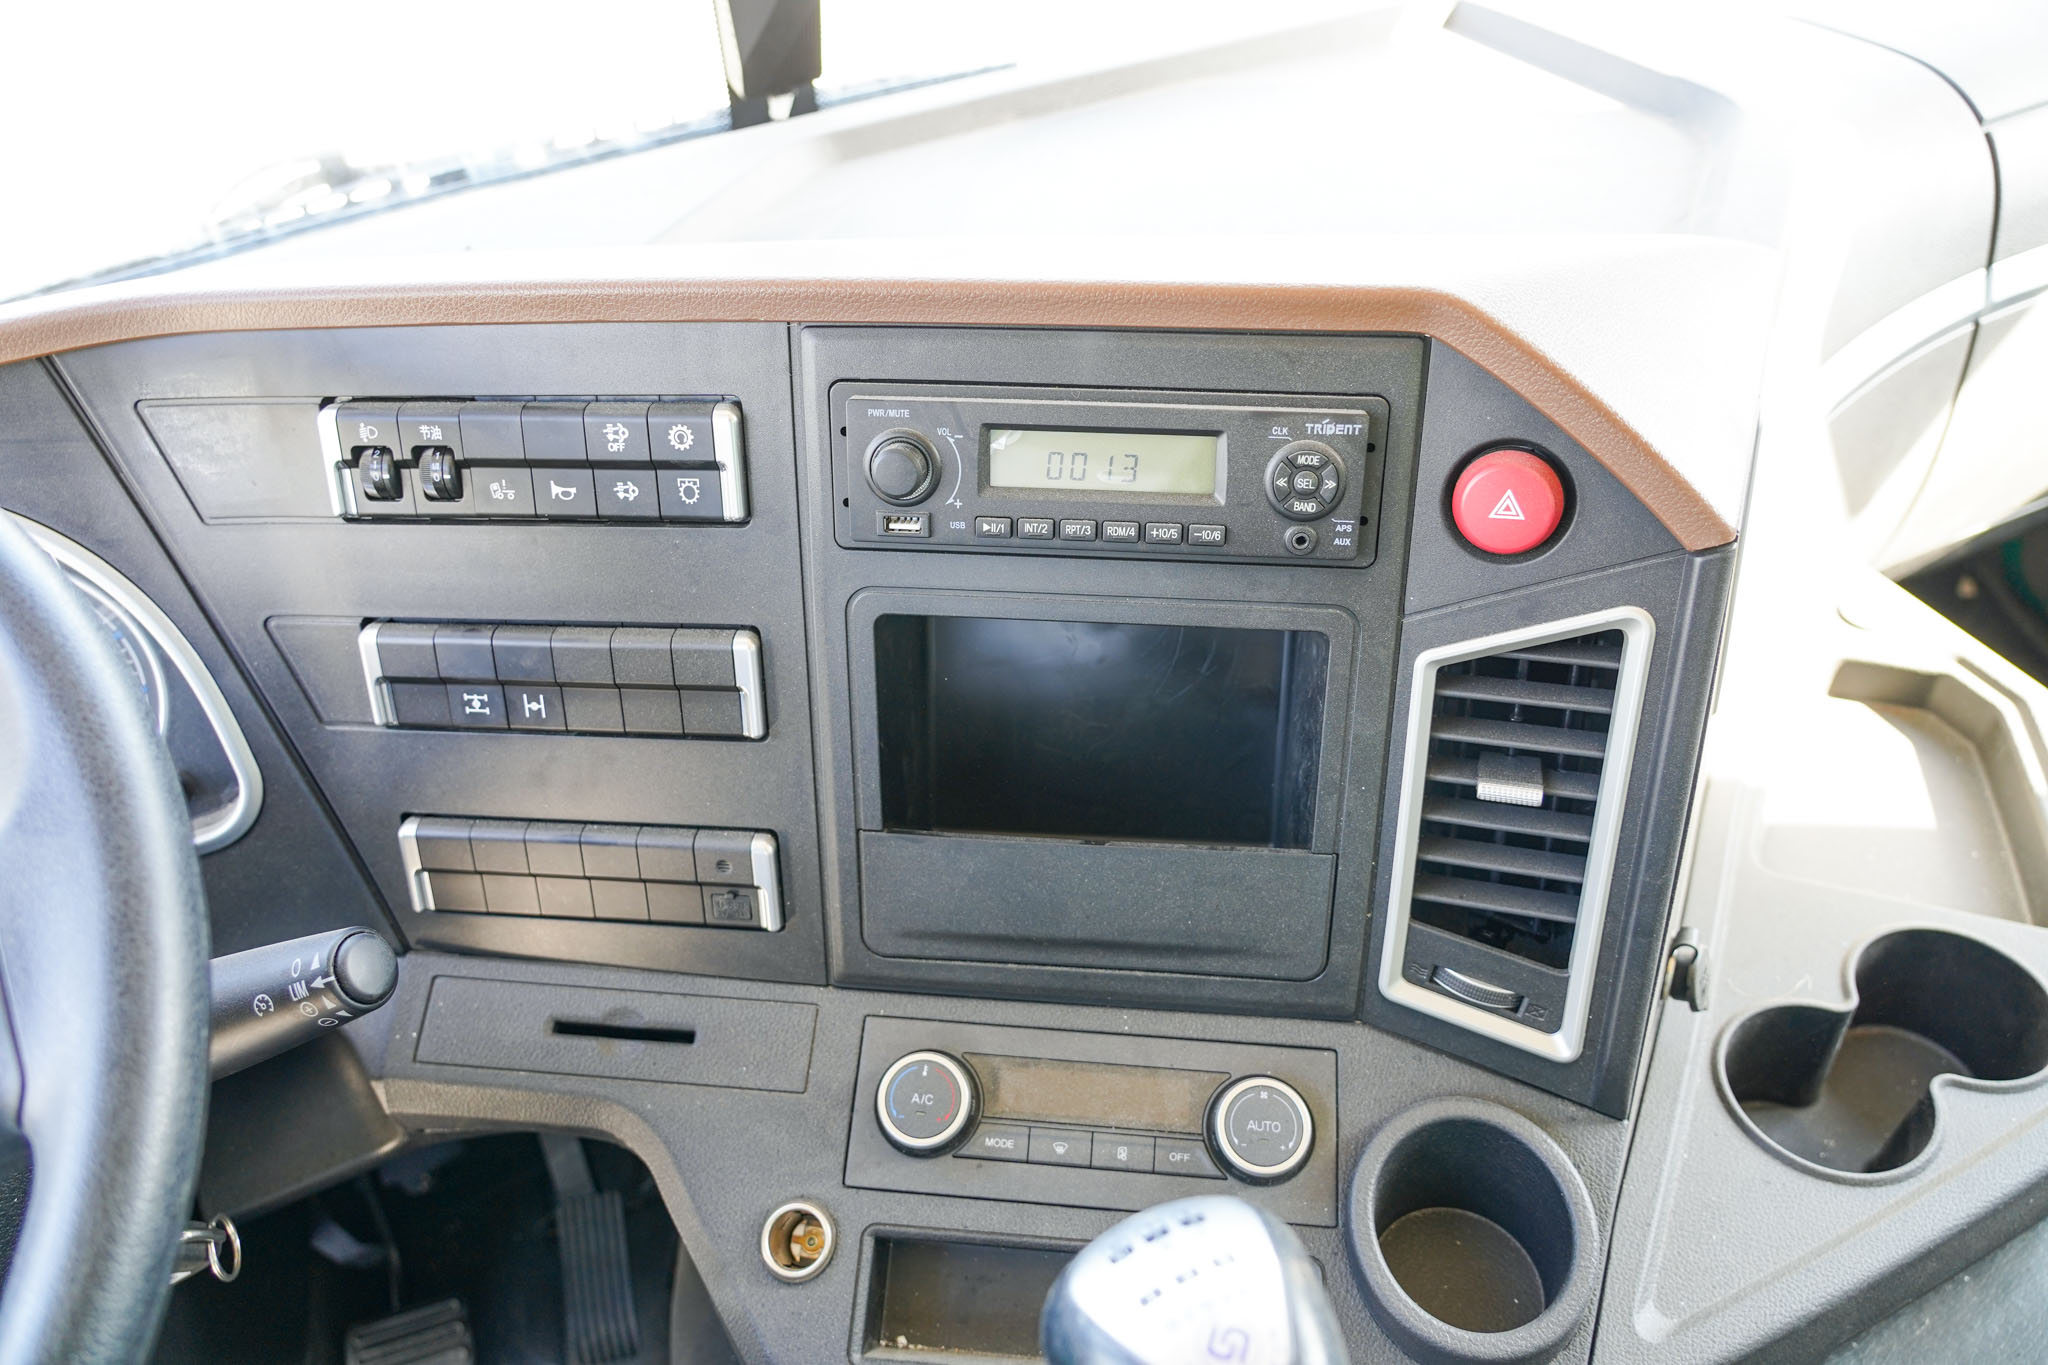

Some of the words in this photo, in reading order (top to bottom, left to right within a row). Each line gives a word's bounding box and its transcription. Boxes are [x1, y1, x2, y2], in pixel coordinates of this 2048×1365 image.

[867, 408, 910, 418] PWR/MUTE
[419, 424, 443, 440] 节油
[936, 427, 951, 437] VOL
[1272, 426, 1288, 436] CLK
[607, 442, 625, 453] OFF
[1297, 454, 1320, 466] MODE
[1297, 478, 1315, 489] SEL
[1293, 501, 1317, 513] BAND
[950, 520, 966, 530] USB
[1024, 522, 1048, 534] INT/2
[1065, 524, 1091, 536] RPT/3
[1335, 523, 1352, 533] APS
[1107, 526, 1135, 538] RDM/4
[1333, 537, 1351, 547] AUX
[288, 979, 310, 1002] LIM
[911, 1092, 934, 1105] A/C
[1247, 1119, 1281, 1133] AUTO
[984, 1136, 1015, 1149] MODE
[1168, 1151, 1191, 1163] OFF
